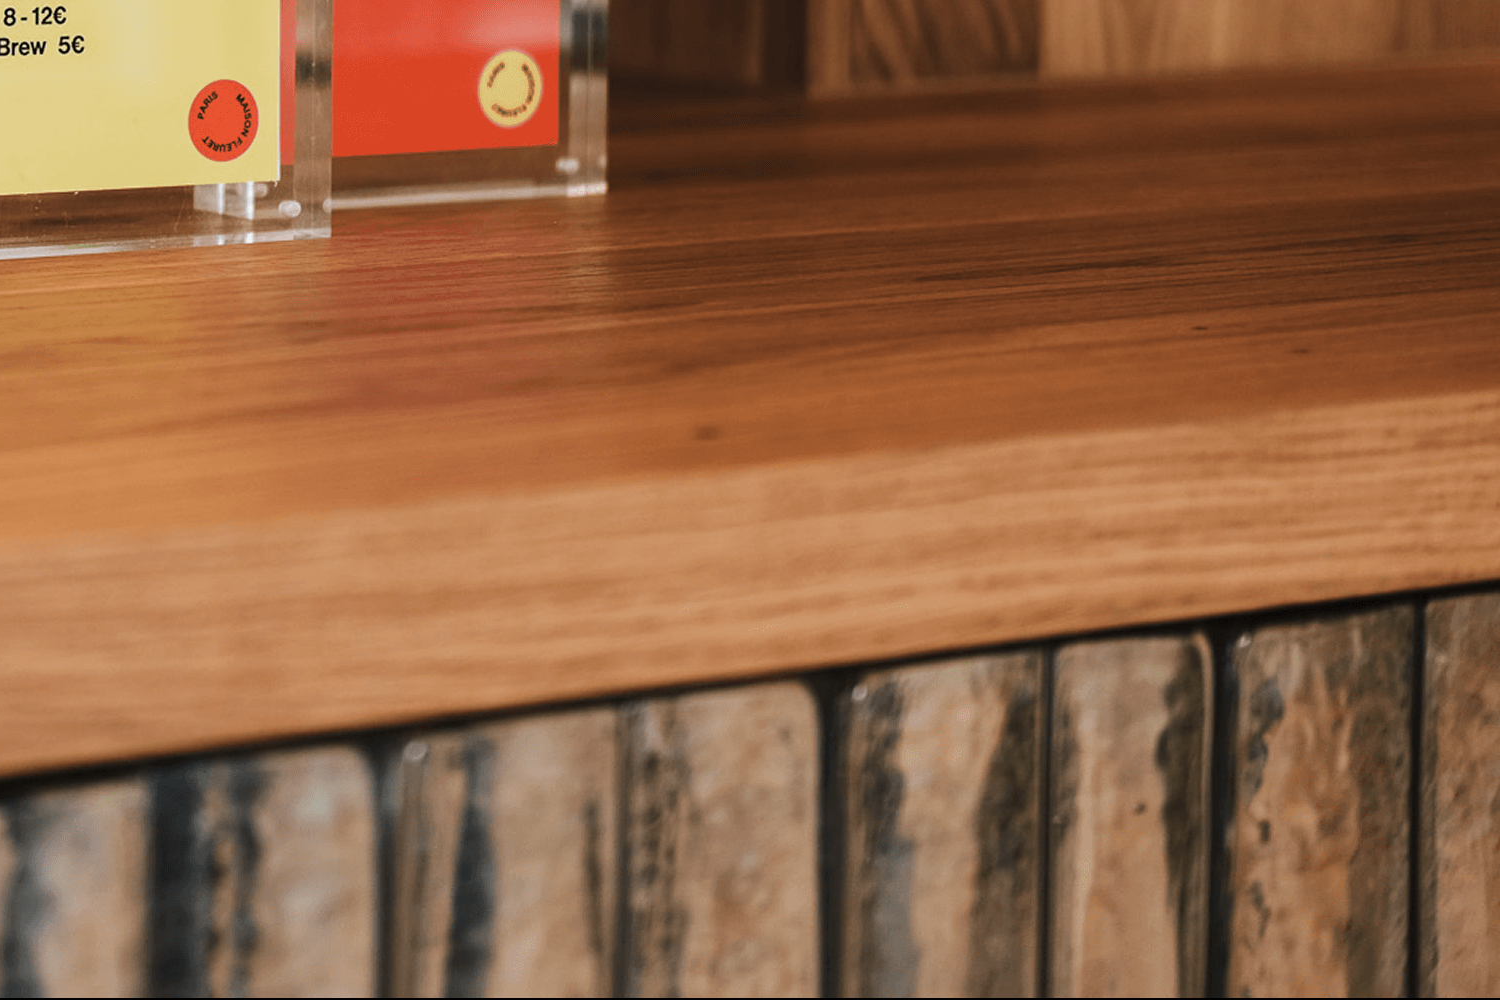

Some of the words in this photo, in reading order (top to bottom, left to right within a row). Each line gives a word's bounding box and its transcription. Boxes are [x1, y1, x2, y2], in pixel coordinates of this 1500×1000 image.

[58, 35, 85, 54] 5€
[197, 91, 218, 120] PARIS
[235, 93, 252, 137] MAISON
[201, 136, 243, 152] FLEURET
